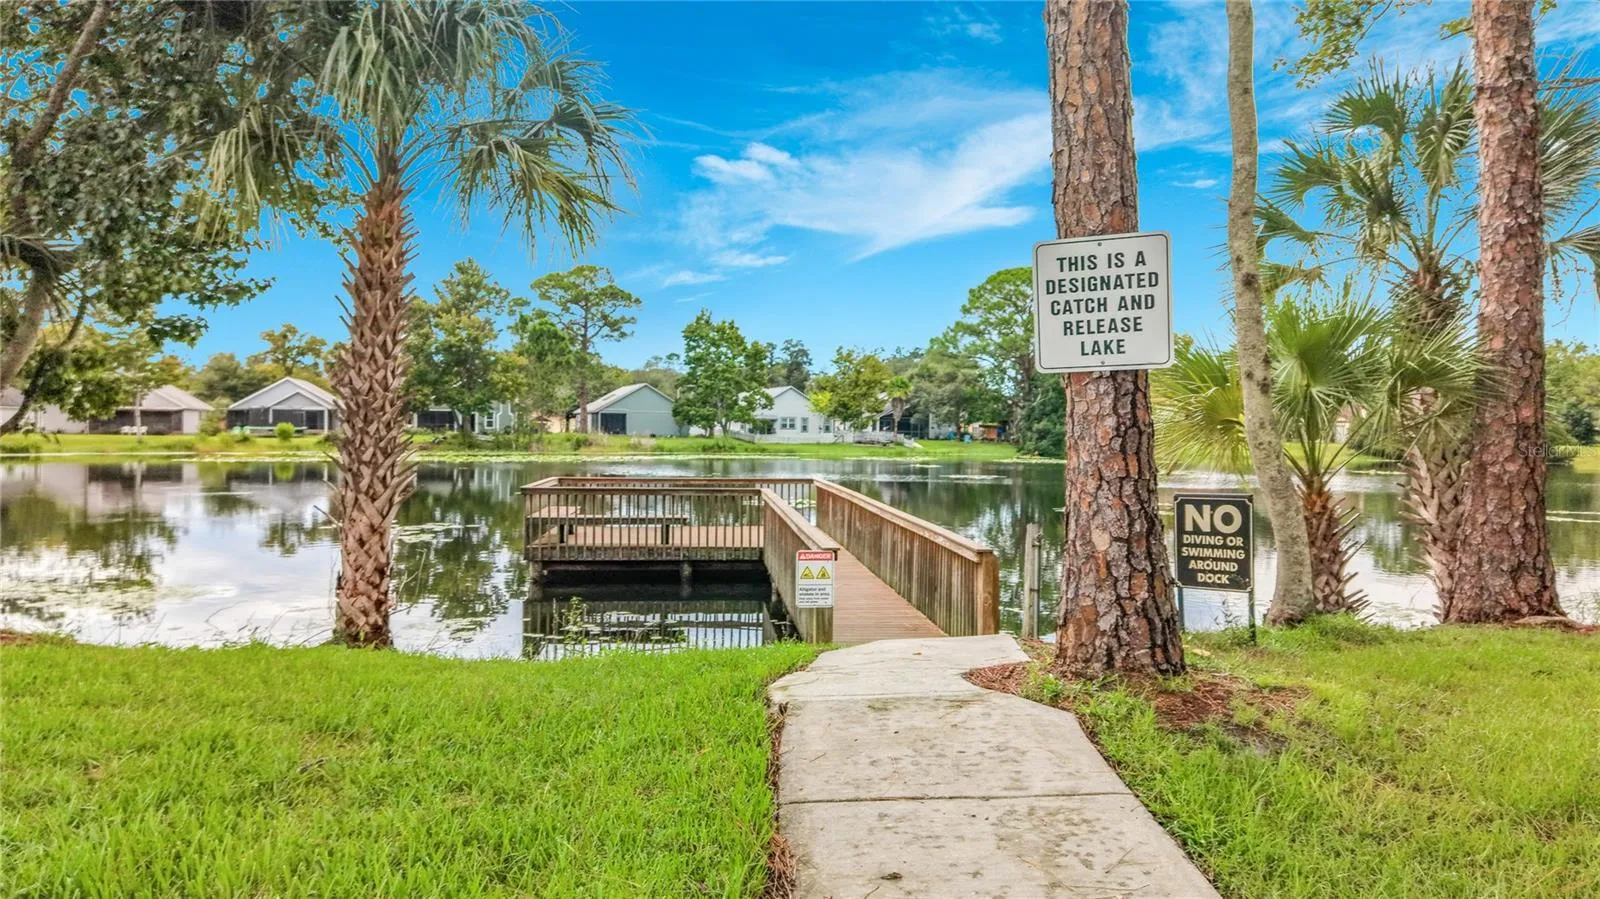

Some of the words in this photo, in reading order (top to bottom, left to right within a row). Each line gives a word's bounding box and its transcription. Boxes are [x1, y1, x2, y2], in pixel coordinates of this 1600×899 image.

[1055, 254, 1098, 273] THIS
[1107, 252, 1125, 269] IS
[1134, 250, 1147, 267] A
[1045, 271, 1159, 295] DESIGNATED
[1050, 296, 1108, 316] CATCH
[1117, 293, 1155, 312] AND
[1063, 316, 1143, 336] RELEASE
[1080, 338, 1126, 356] LAKE
[1184, 503, 1243, 534] NO
[1182, 534, 1224, 546] DIVING
[1226, 536, 1244, 547] OR
[805, 552, 832, 560] DANGER
[1181, 546, 1246, 560] SWIMMING
[1188, 559, 1239, 572] AROUND
[1197, 572, 1230, 585] DOCK
